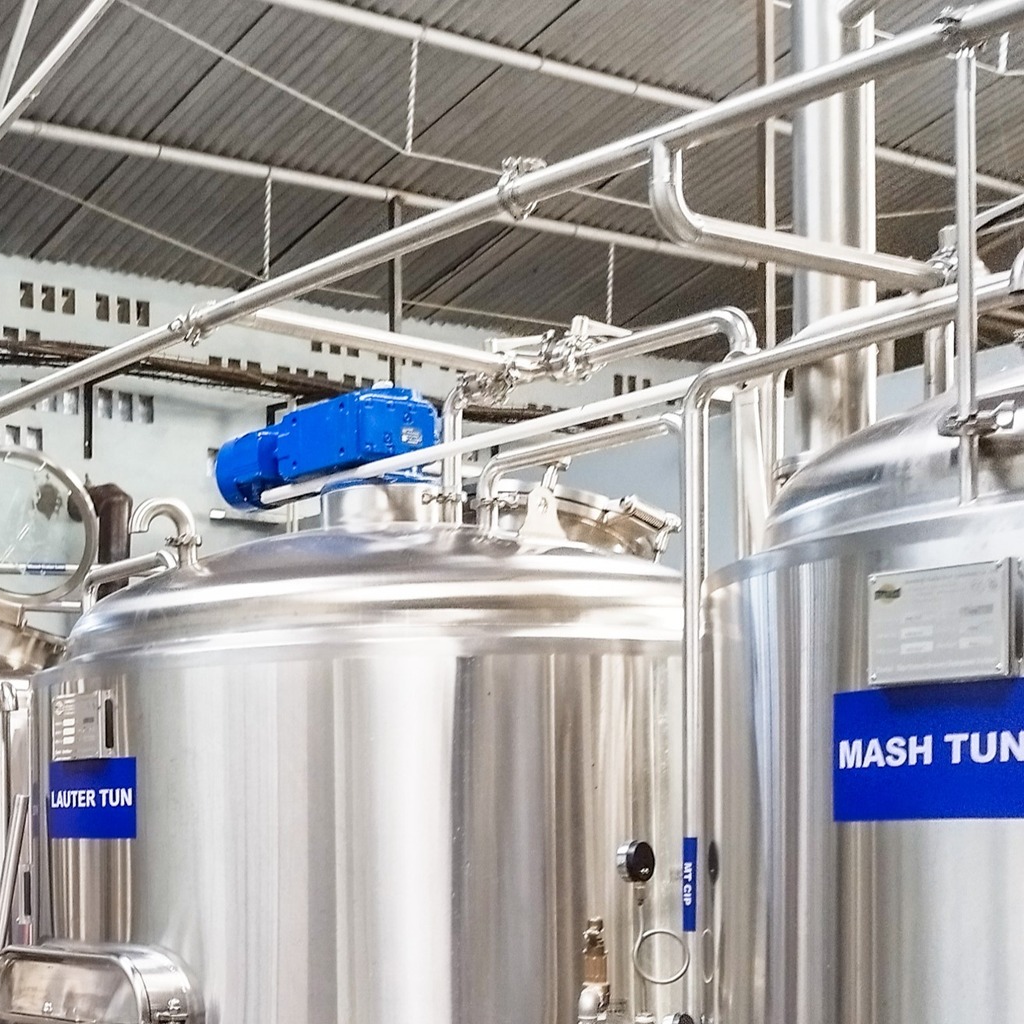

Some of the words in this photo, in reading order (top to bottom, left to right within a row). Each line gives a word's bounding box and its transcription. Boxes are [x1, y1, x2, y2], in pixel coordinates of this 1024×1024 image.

[839, 734, 933, 769] MASH
[944, 729, 1024, 764] TUN
[51, 789, 96, 809] LAUTER
[98, 788, 133, 808] TUN
[683, 862, 692, 882] MT
[683, 884, 692, 906] CIP
